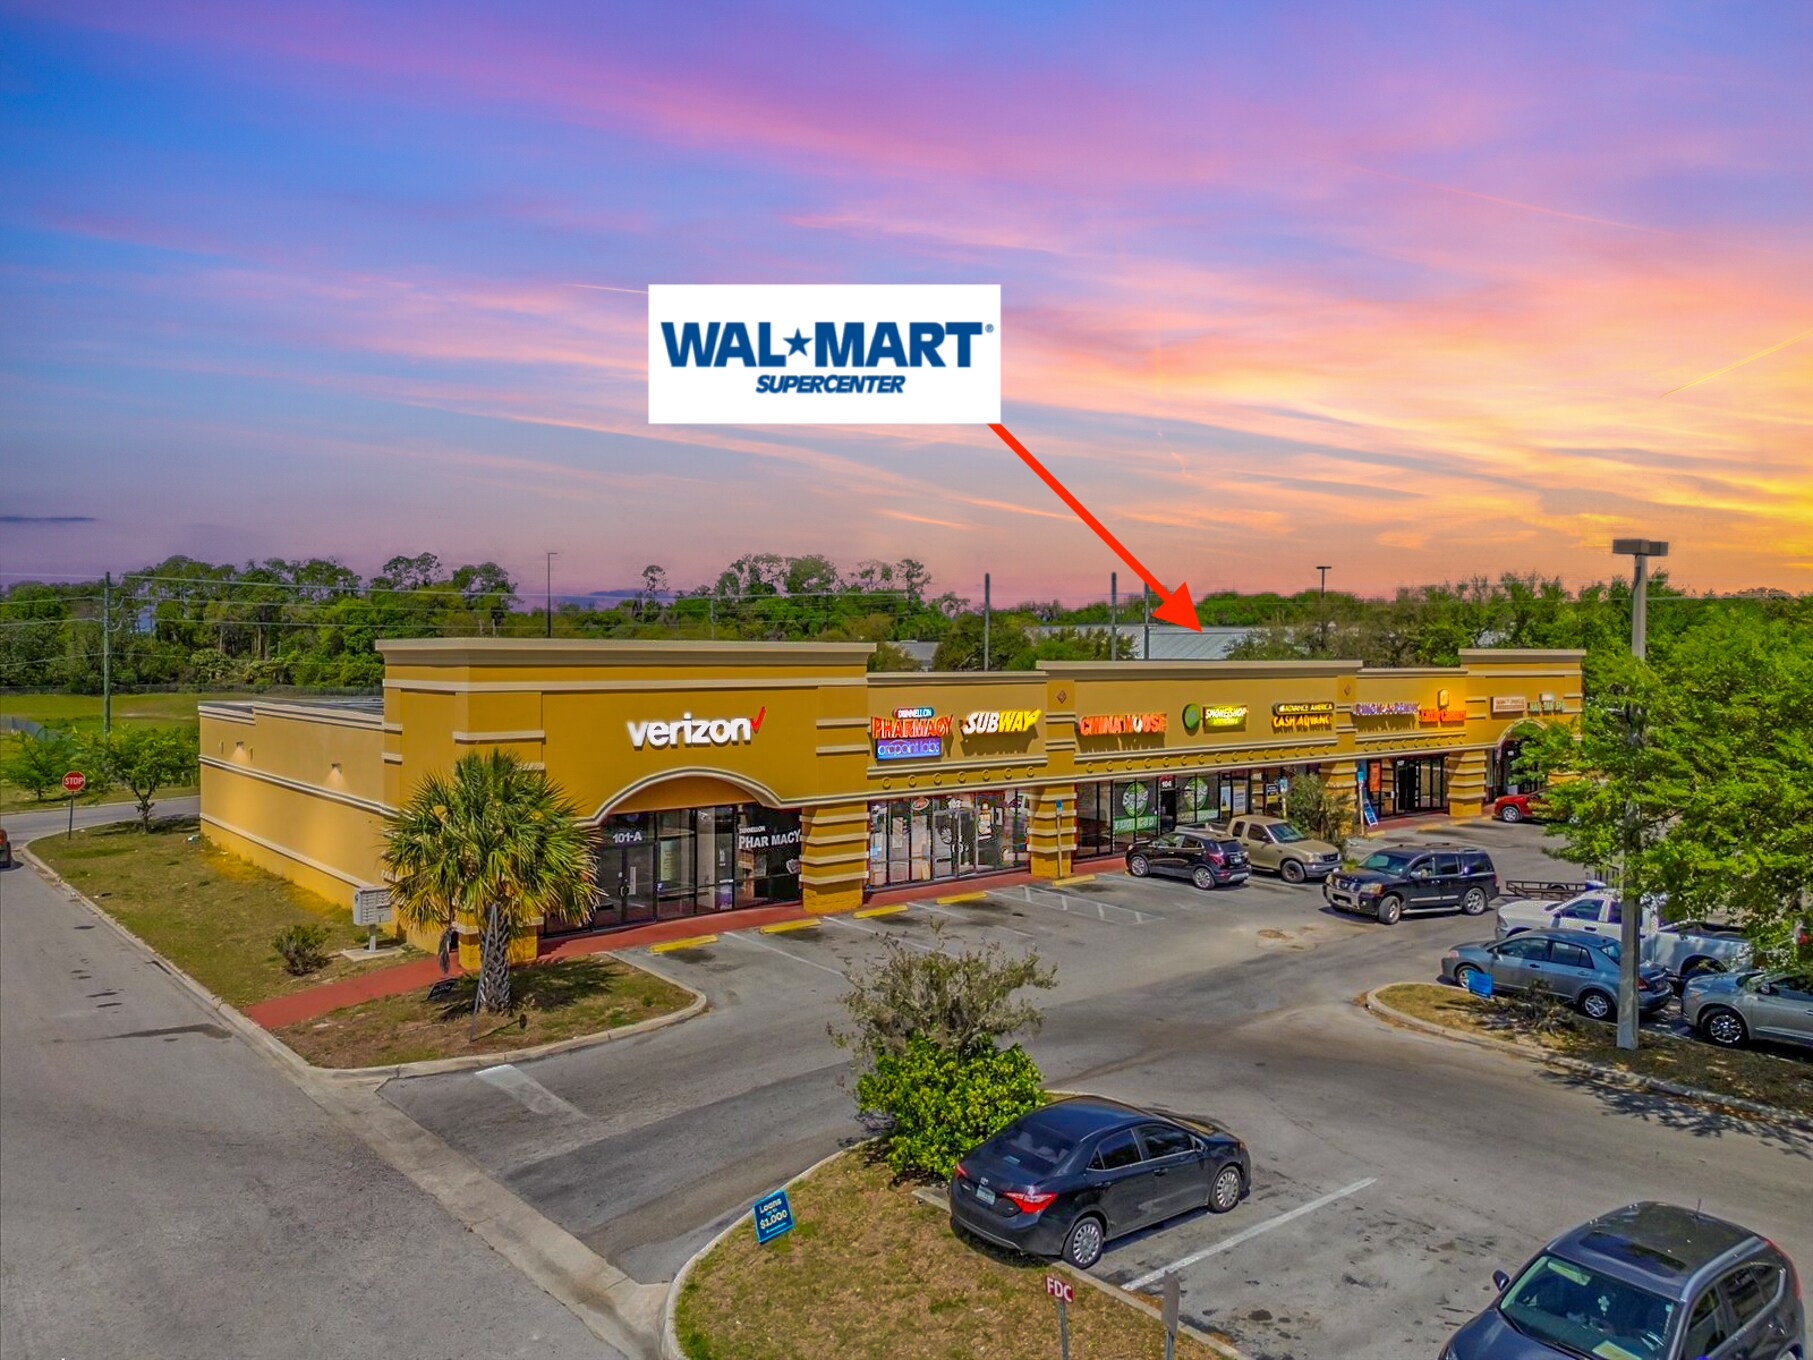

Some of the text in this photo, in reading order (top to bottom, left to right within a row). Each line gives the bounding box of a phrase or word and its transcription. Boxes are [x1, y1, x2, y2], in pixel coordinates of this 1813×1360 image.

[626, 711, 751, 749] verizon
[871, 714, 954, 740] PHARMACY
[960, 708, 1041, 736] SUBWAY
[1079, 713, 1168, 737] CHINA HOUSE
[1273, 715, 1295, 728] CASH
[64, 777, 84, 785] STOP
[612, 831, 643, 844] 101-A
[738, 828, 800, 850] PHAR MACY
[759, 1198, 782, 1214] Loans
[1046, 1276, 1073, 1303] FDC
